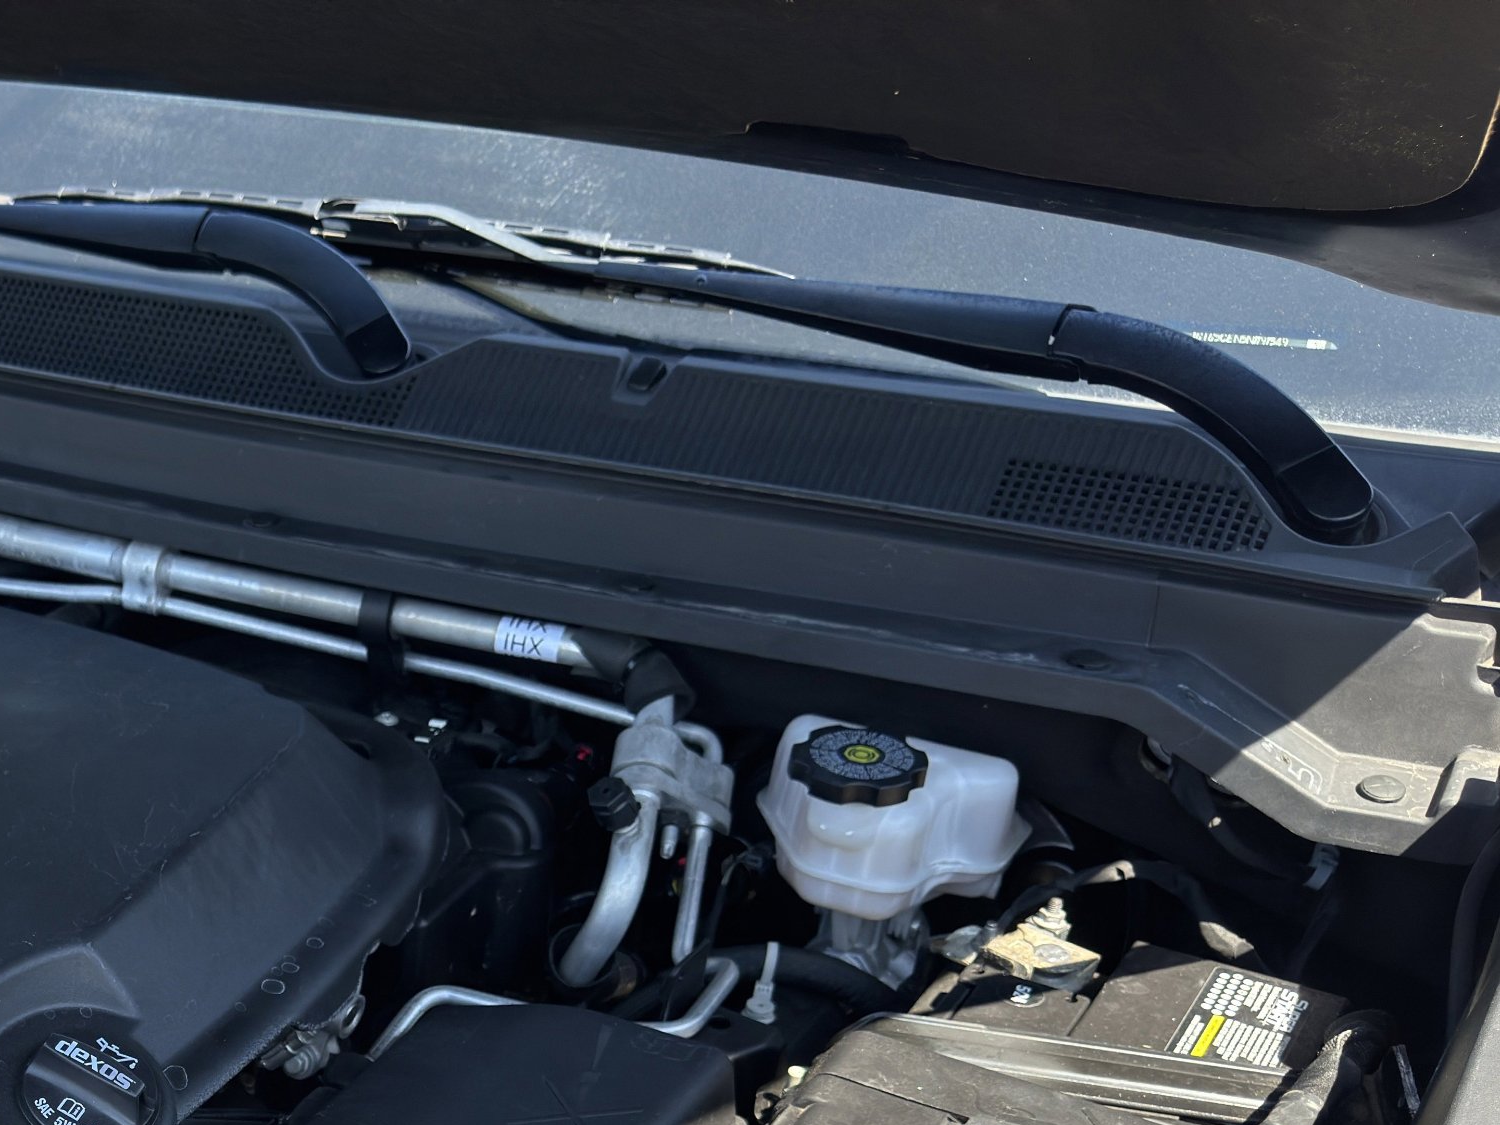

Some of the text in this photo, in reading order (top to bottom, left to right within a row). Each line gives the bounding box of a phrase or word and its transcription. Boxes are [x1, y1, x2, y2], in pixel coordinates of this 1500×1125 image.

[504, 632, 544, 656] IHX
[55, 1040, 134, 1090] dexos
[34, 1097, 55, 1119] SAE
